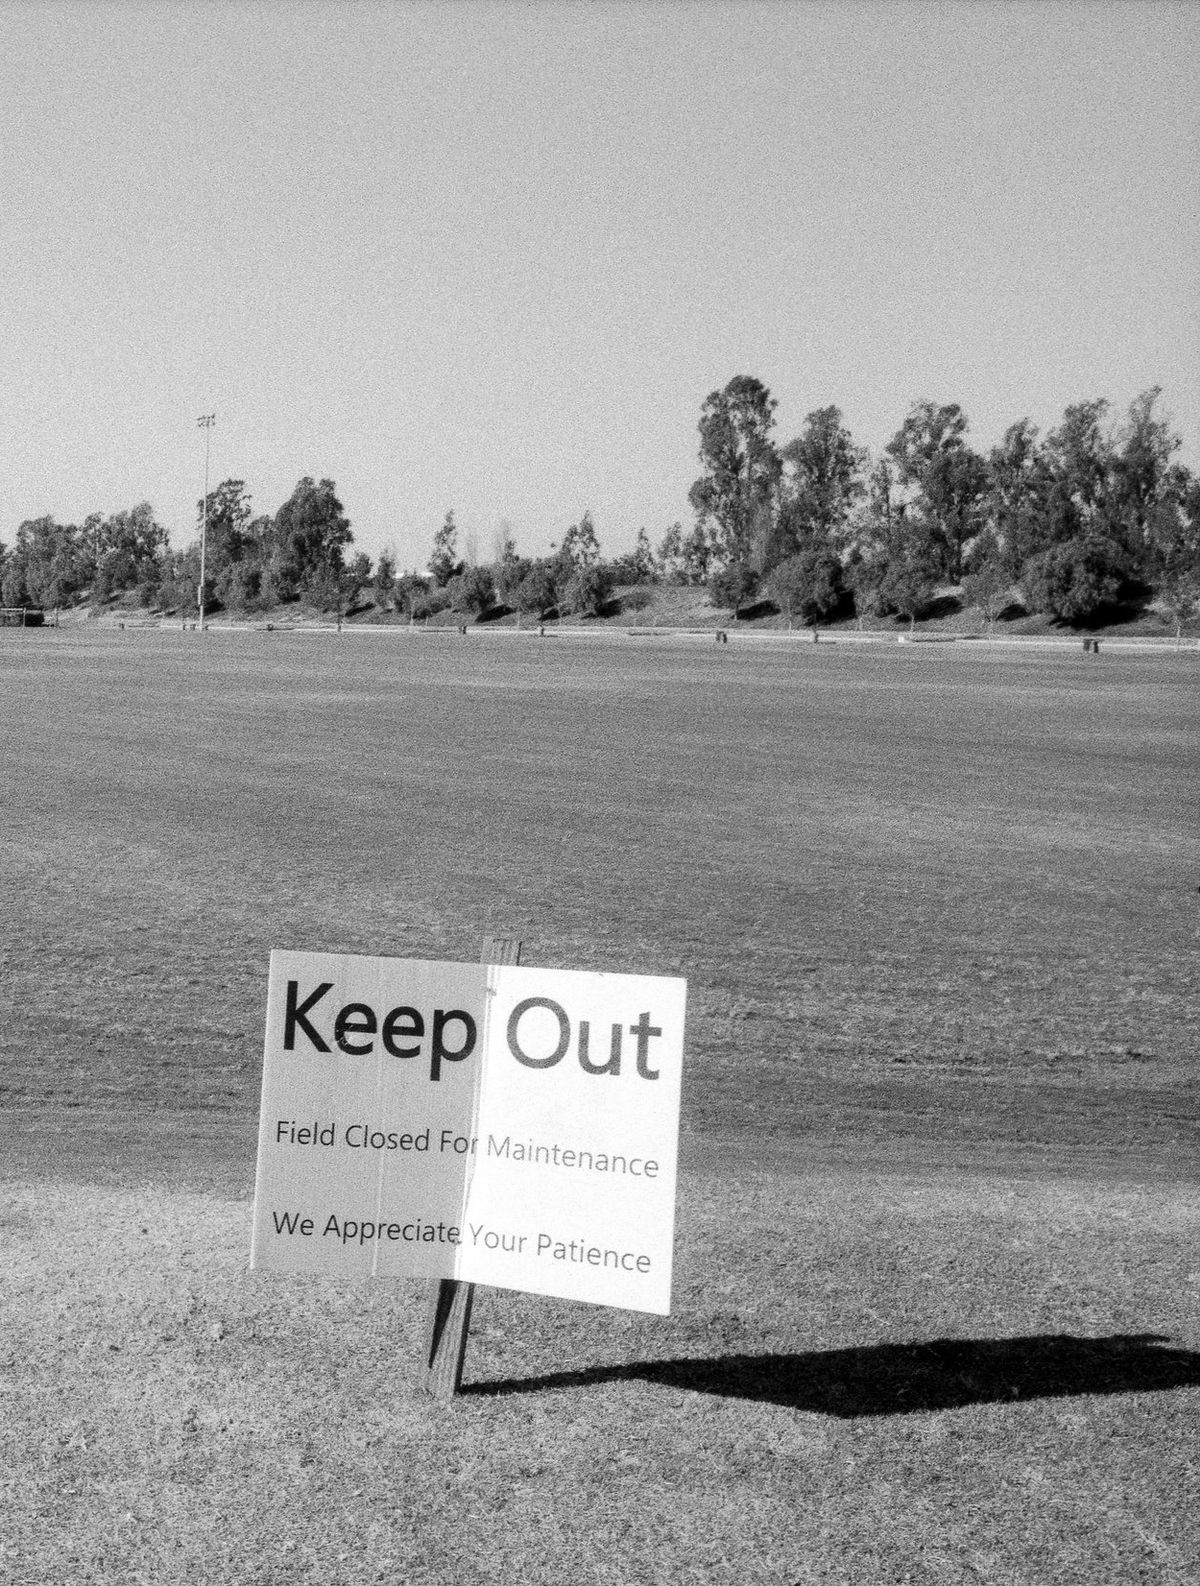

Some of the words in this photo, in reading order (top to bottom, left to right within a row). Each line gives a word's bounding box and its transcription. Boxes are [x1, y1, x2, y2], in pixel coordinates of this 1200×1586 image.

[282, 979, 478, 1082] Keep
[506, 996, 663, 1081] Out
[275, 1120, 336, 1147] Field
[344, 1124, 430, 1152] Closed
[439, 1130, 479, 1155] For
[487, 1134, 660, 1178] Maintenance
[272, 1211, 315, 1237] We
[322, 1214, 461, 1245] Appreciate
[468, 1222, 528, 1254] Your
[536, 1233, 652, 1274] Patience
